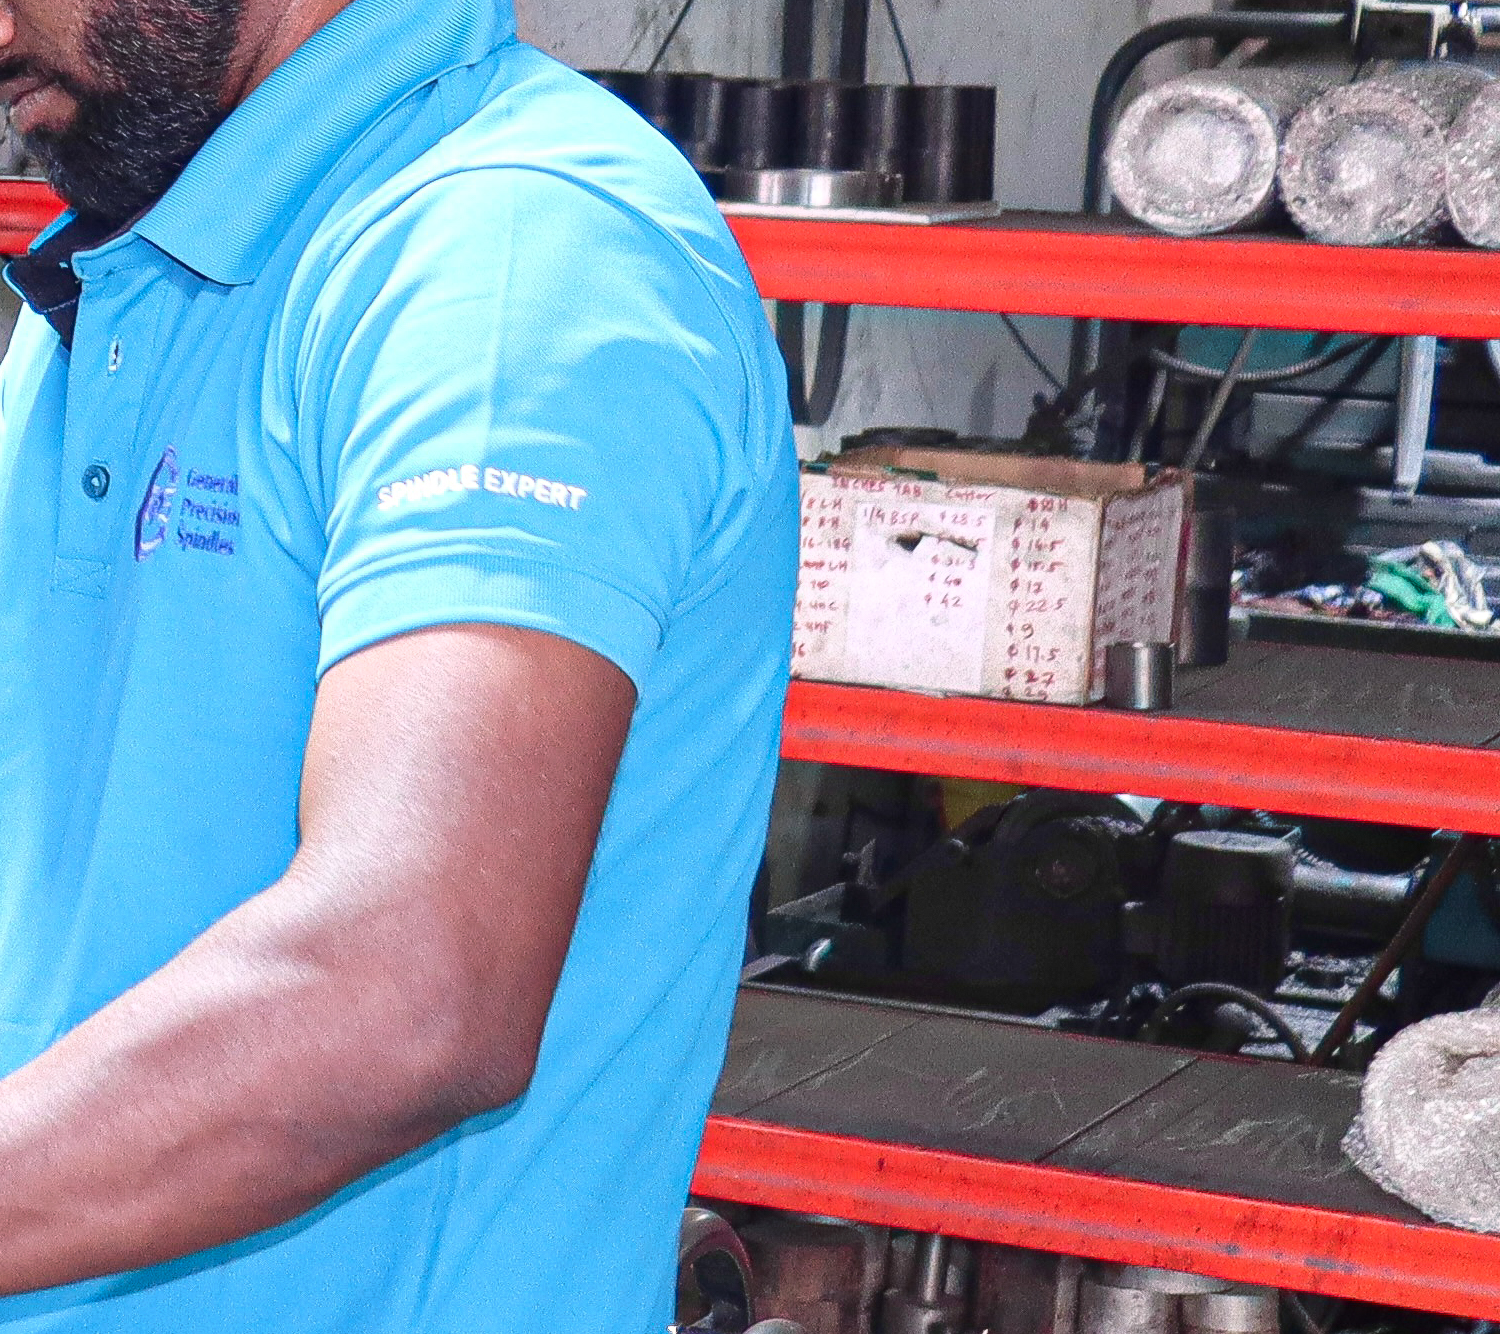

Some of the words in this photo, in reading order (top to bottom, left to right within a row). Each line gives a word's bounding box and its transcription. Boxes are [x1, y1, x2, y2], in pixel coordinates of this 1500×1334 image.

[187, 467, 238, 495] General
[377, 464, 480, 512] SPINDLE
[483, 466, 589, 512] EXPERT
[176, 519, 235, 556] Spindles
